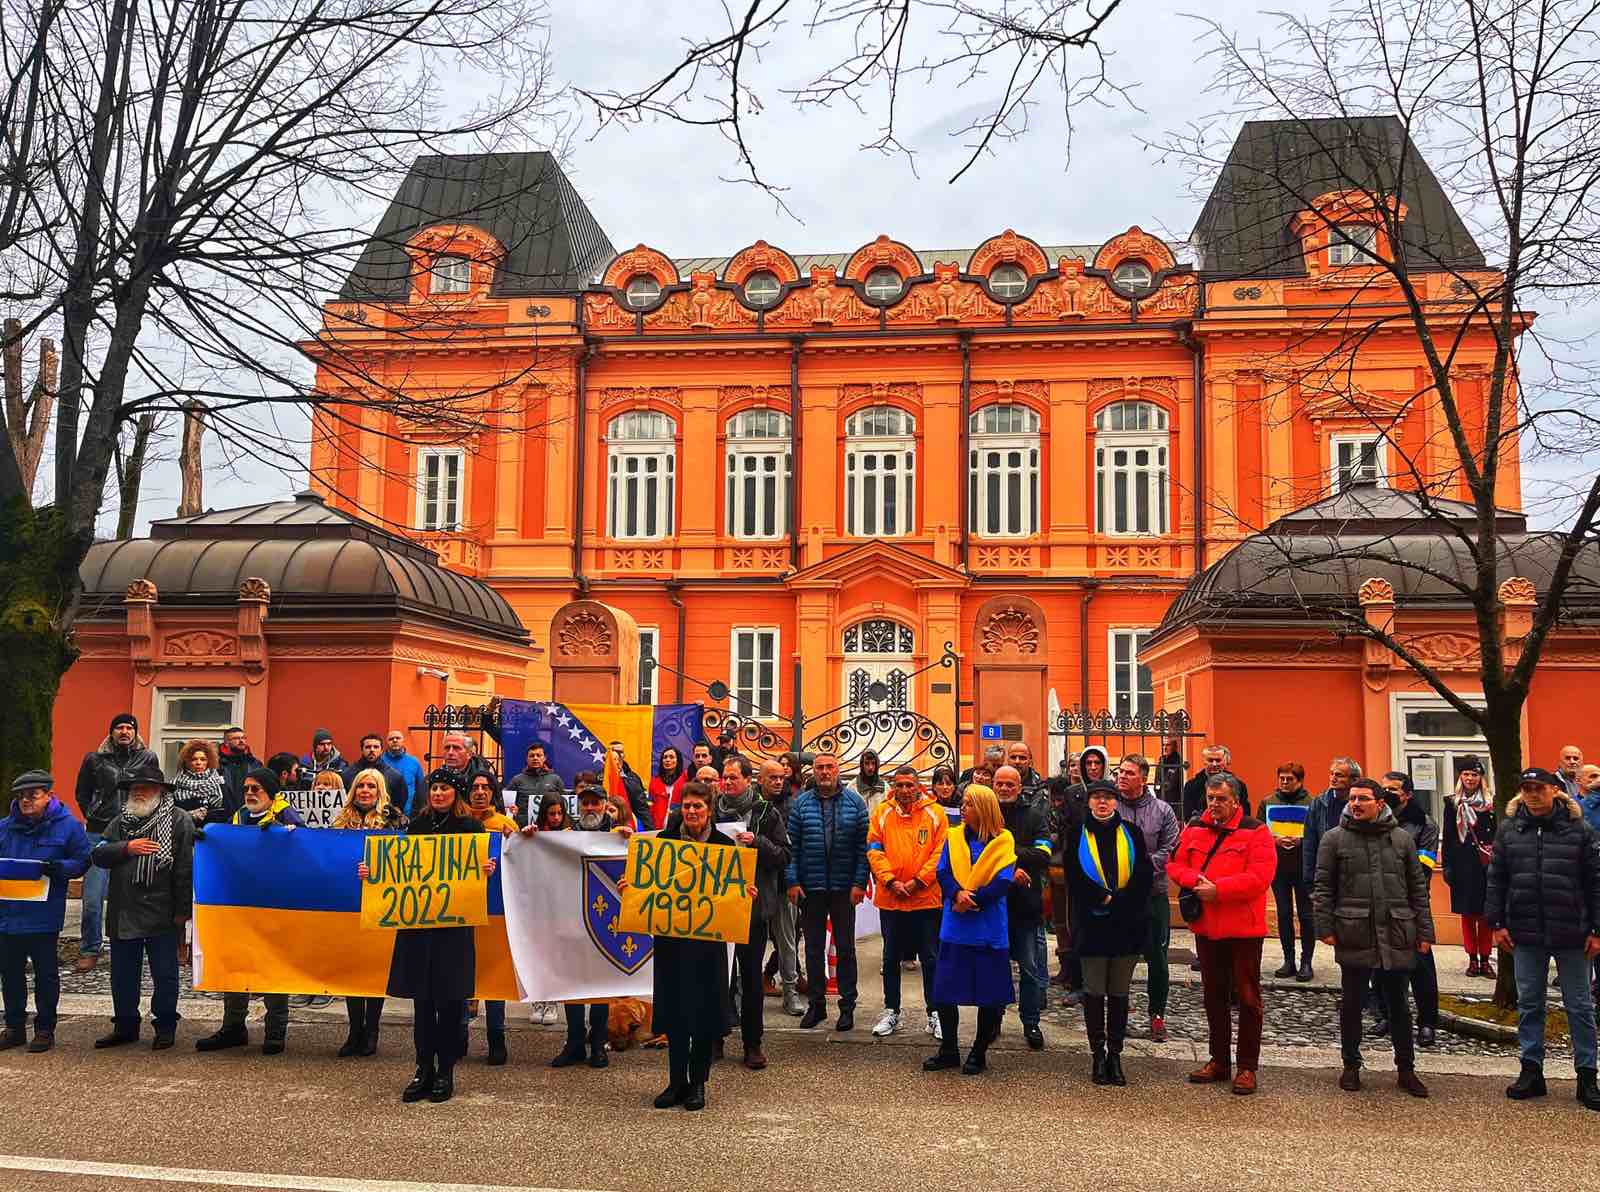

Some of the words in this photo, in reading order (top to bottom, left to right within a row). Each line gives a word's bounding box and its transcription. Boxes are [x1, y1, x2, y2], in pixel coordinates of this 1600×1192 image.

[366, 835, 480, 884] UKRAJINA
[631, 839, 747, 898] BOSNA
[378, 883, 466, 927] 2022.
[639, 891, 723, 940] 1992.
